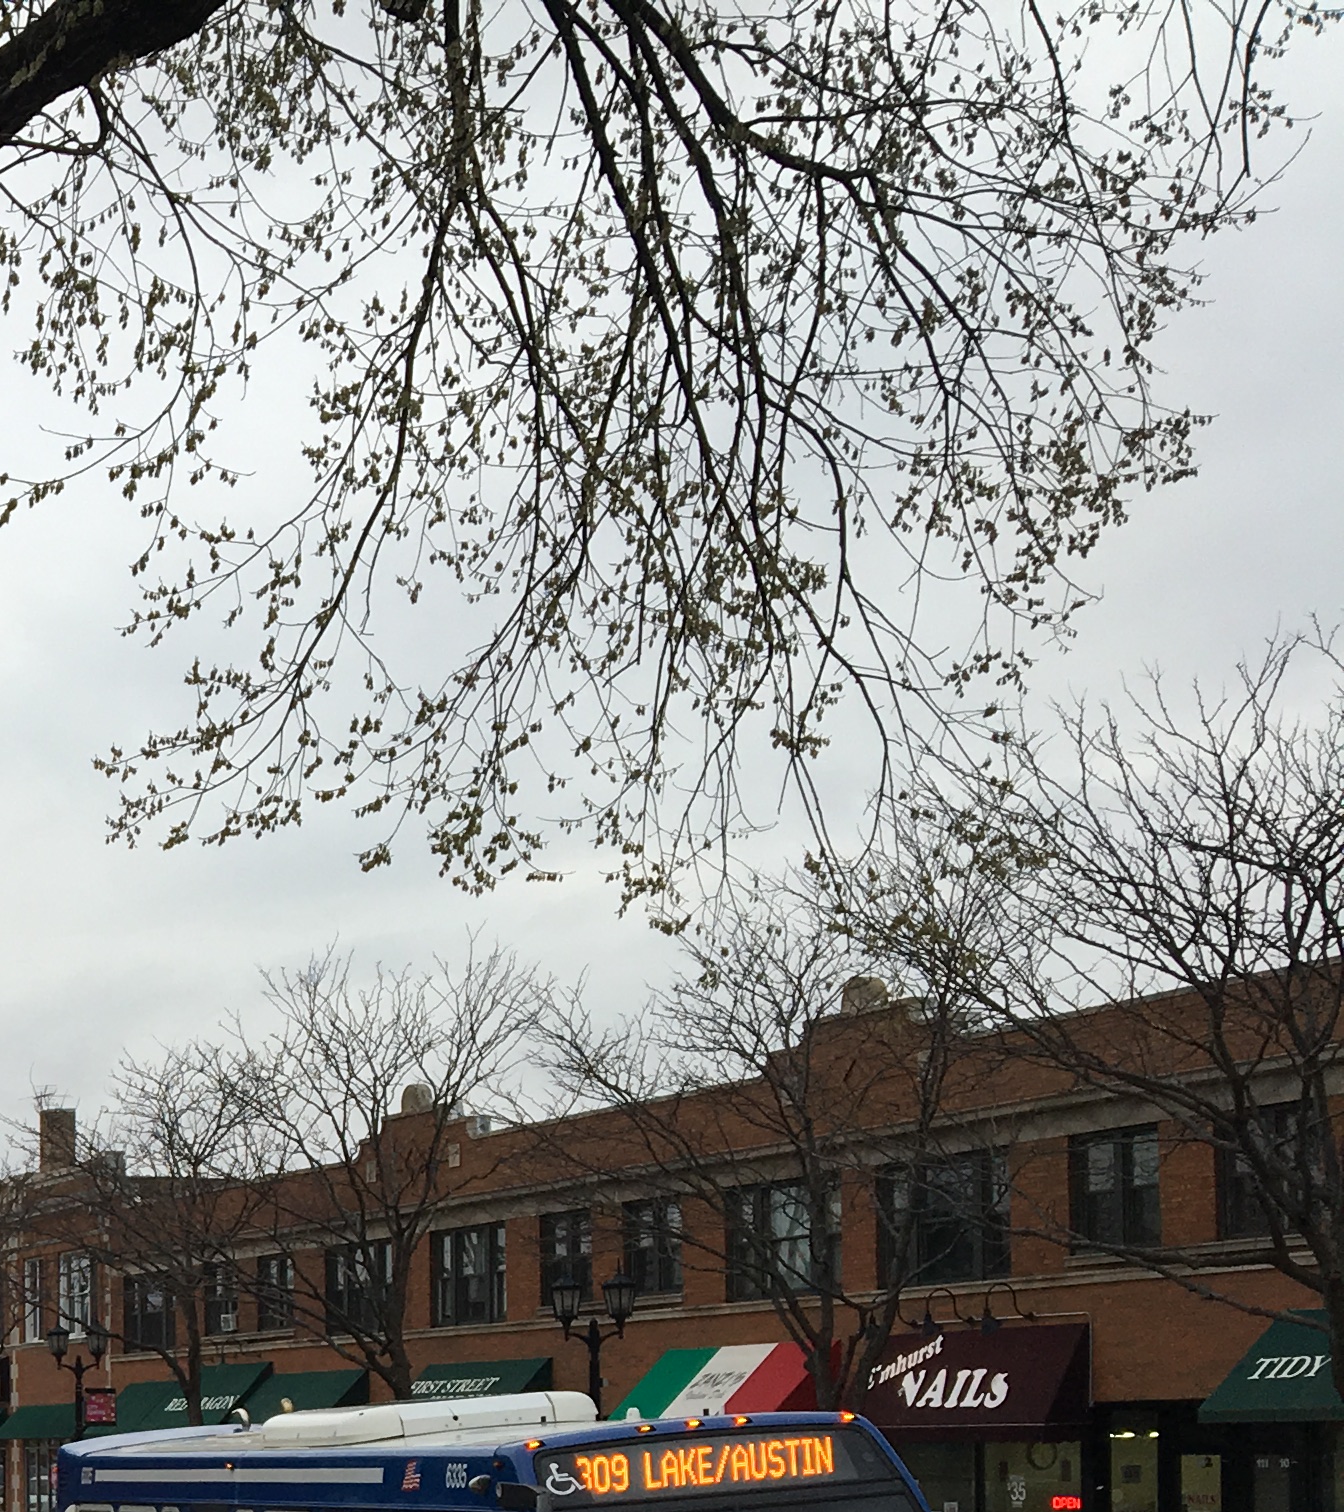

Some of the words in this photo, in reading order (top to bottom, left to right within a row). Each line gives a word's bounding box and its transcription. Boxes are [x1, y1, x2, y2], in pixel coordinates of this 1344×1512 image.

[1246, 1354, 1332, 1380] TIDY
[410, 1380, 447, 1395] FIRST
[441, 1376, 501, 1394] STREET
[897, 1367, 1010, 1409] NAILS
[445, 1462, 468, 1489] 6335
[576, 1453, 630, 1494] 309
[642, 1436, 835, 1491] LAKE/AUSTIN
[1051, 1495, 1082, 1511] OPEN
